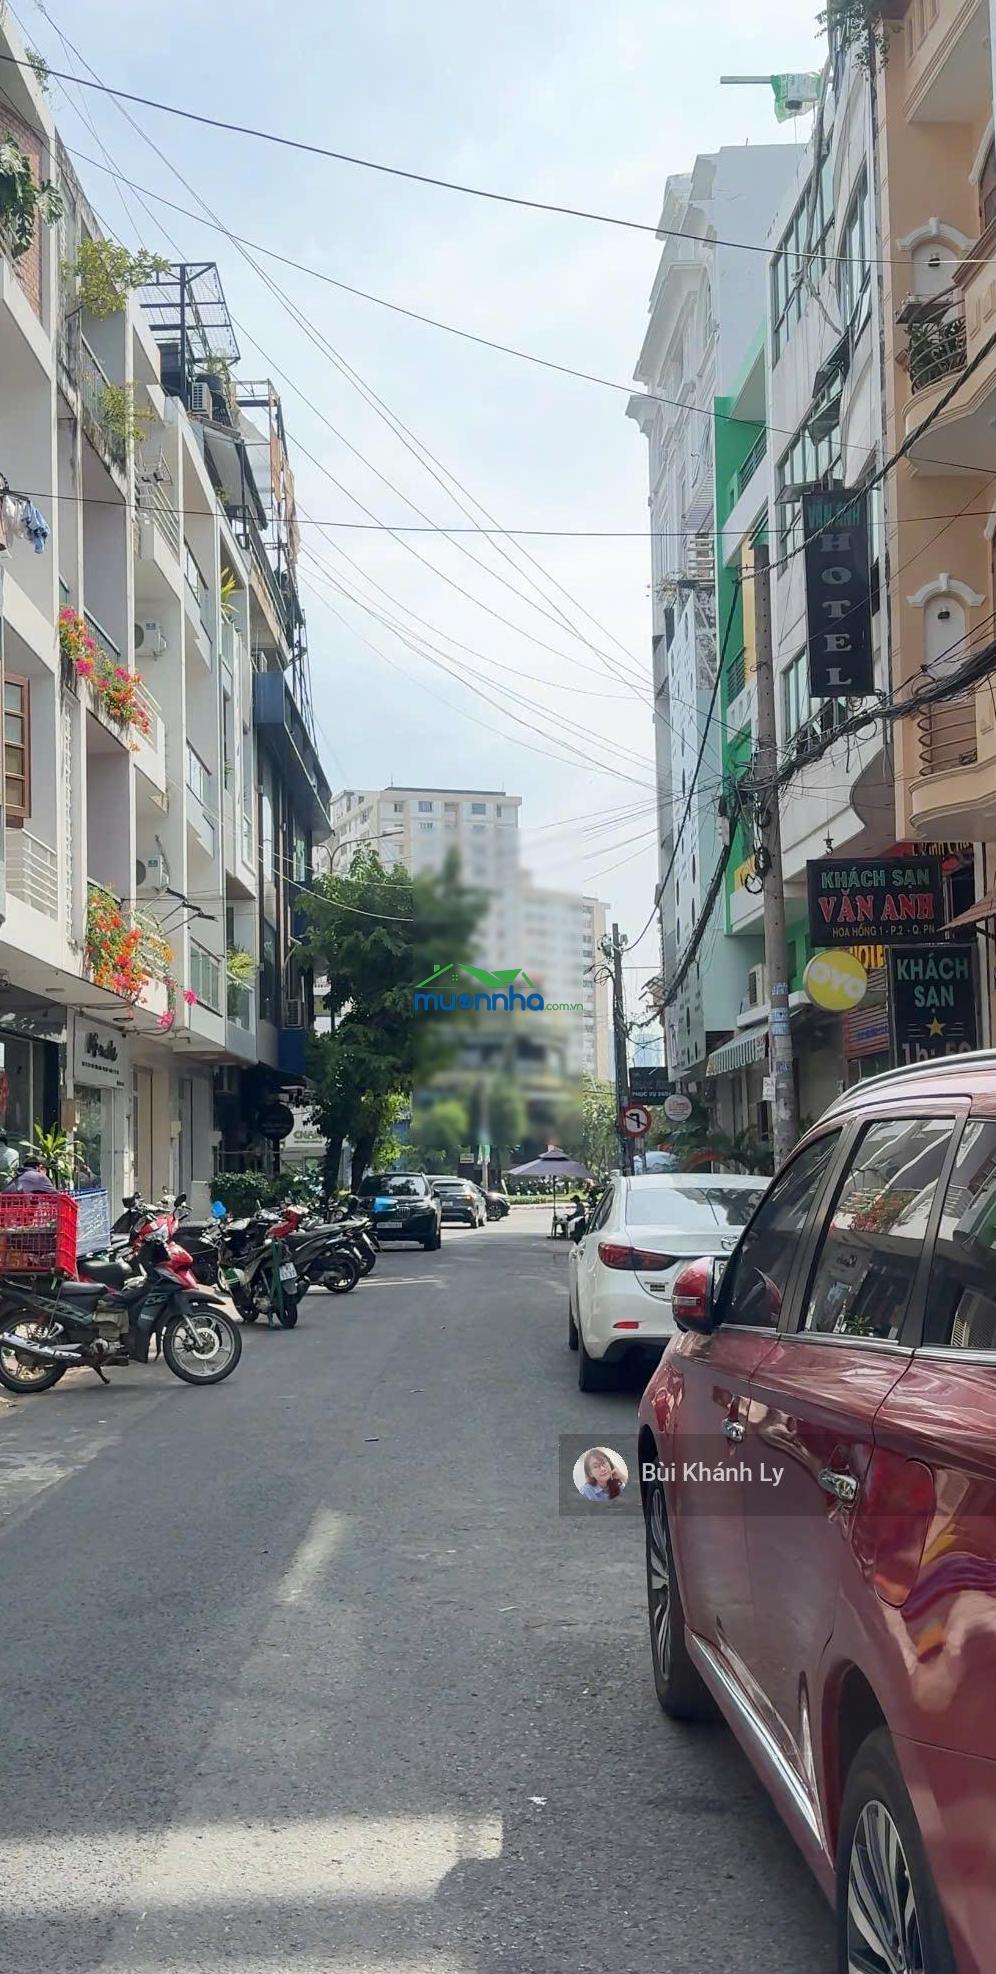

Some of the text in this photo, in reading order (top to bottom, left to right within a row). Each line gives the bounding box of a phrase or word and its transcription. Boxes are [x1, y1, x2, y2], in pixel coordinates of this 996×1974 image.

[820, 533, 852, 686] HOTEL
[821, 867, 930, 889] KHÁCH SẠN
[880, 893, 935, 920] ANH
[832, 926, 850, 938] HOA
[809, 961, 867, 999] OYO
[896, 953, 969, 980] KHÁCH
[914, 985, 954, 1014] SẠN
